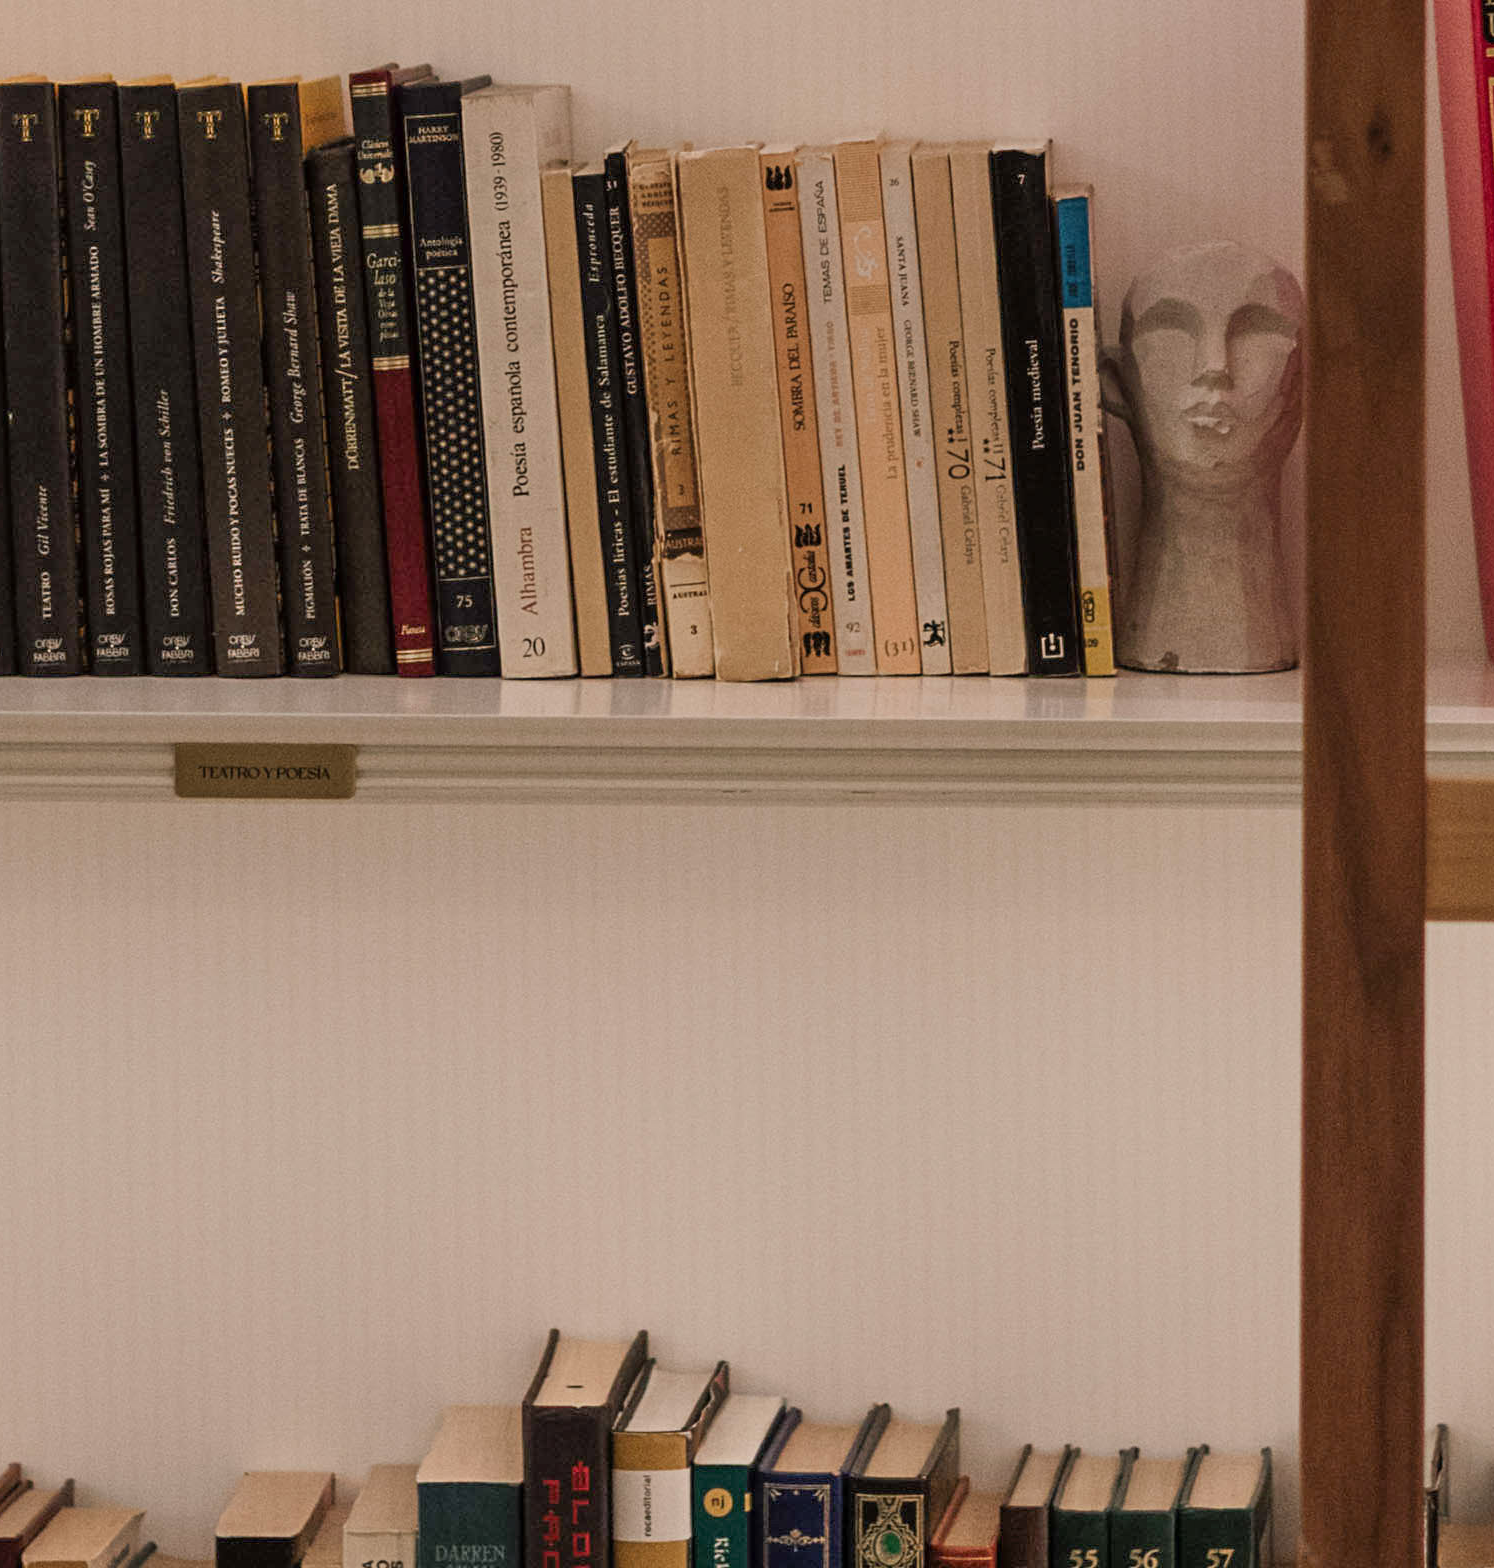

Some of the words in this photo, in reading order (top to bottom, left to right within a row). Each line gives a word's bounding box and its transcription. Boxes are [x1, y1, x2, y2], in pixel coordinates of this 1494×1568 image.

[494, 221, 521, 354] contemporánea
[510, 360, 527, 435] española
[1027, 339, 1043, 403] medieval
[1031, 406, 1045, 449] Poesía
[511, 443, 530, 497] Poesía
[518, 526, 538, 615] Alhambra
[522, 638, 546, 658] 20
[199, 766, 259, 780] TEATRO
[261, 767, 272, 778] Y
[276, 766, 330, 780] POESÍA
